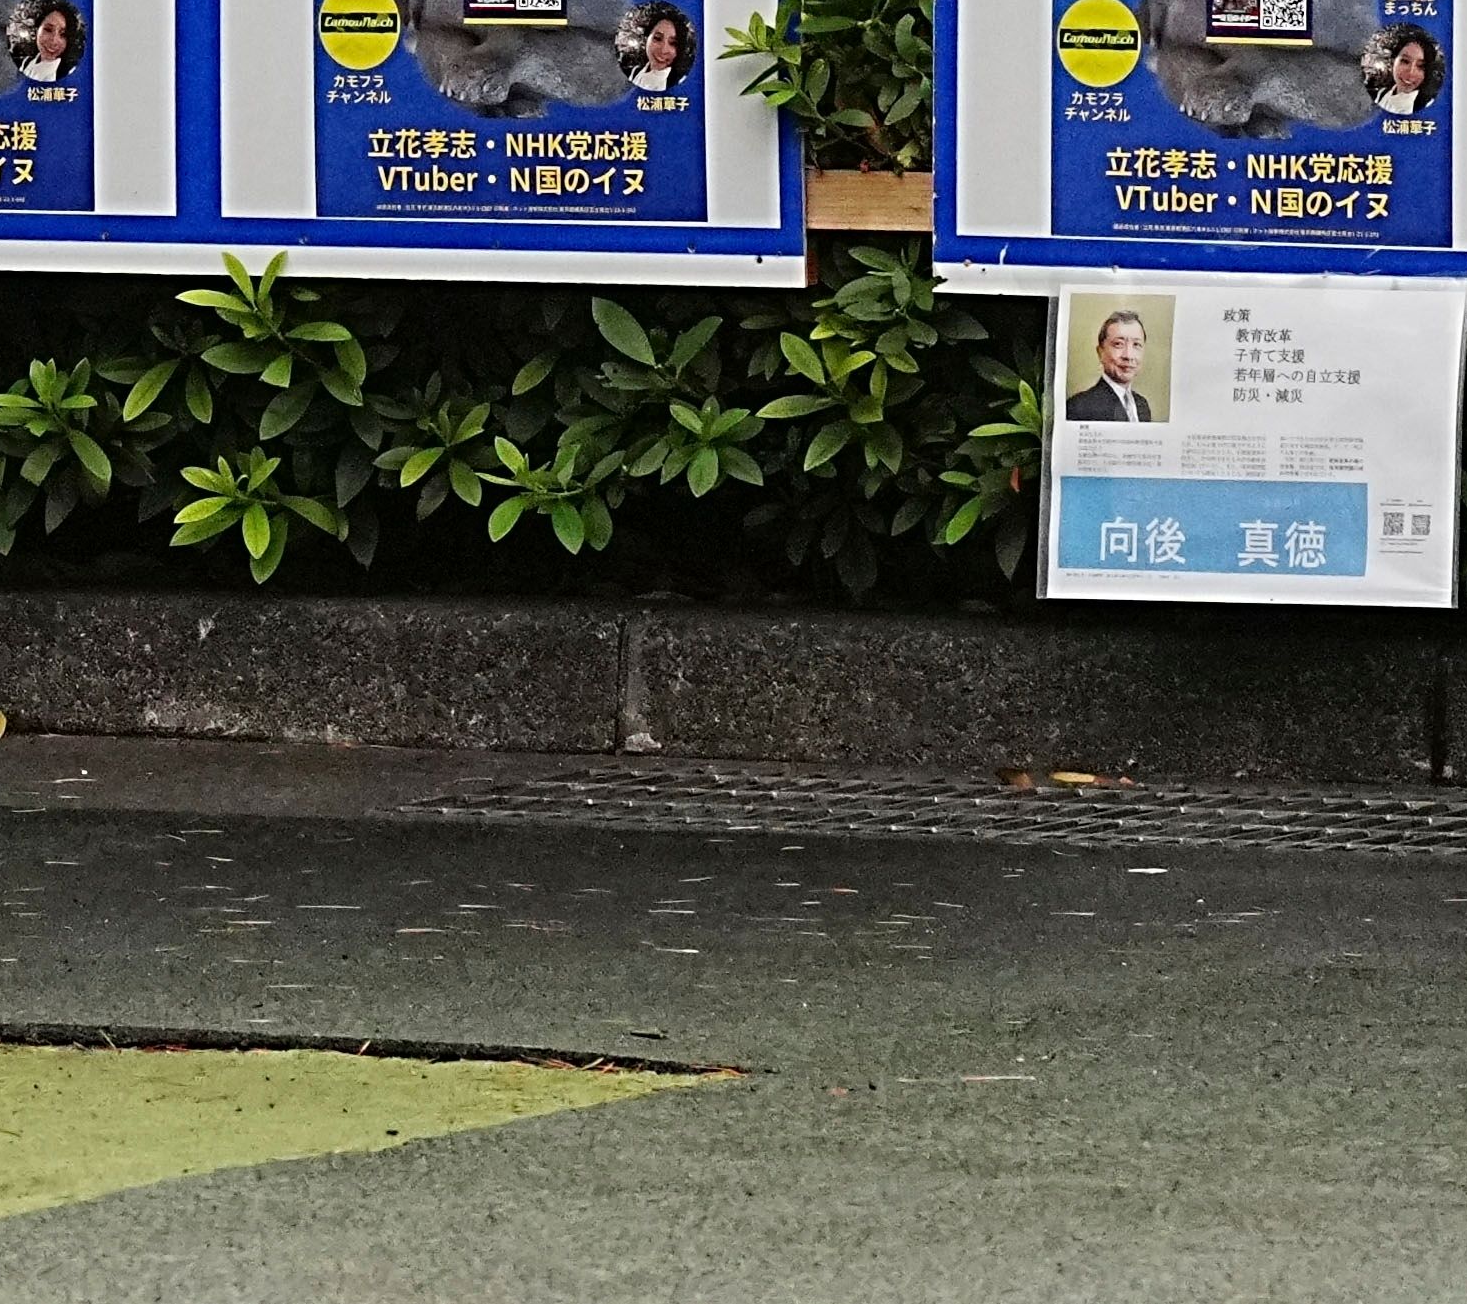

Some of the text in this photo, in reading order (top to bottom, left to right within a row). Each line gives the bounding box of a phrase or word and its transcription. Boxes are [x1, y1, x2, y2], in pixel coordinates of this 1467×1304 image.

[368, 125, 648, 165] 立花孝志・NHK党応援
[1223, 310, 1250, 321] 政策
[1236, 329, 1292, 342] 教育改革
[1234, 349, 1304, 363] 子育て支援
[1233, 370, 1360, 384] 若年層への自立支援
[1233, 389, 1303, 403] 防災・減災
[1100, 517, 1326, 567] 向後 真徳
